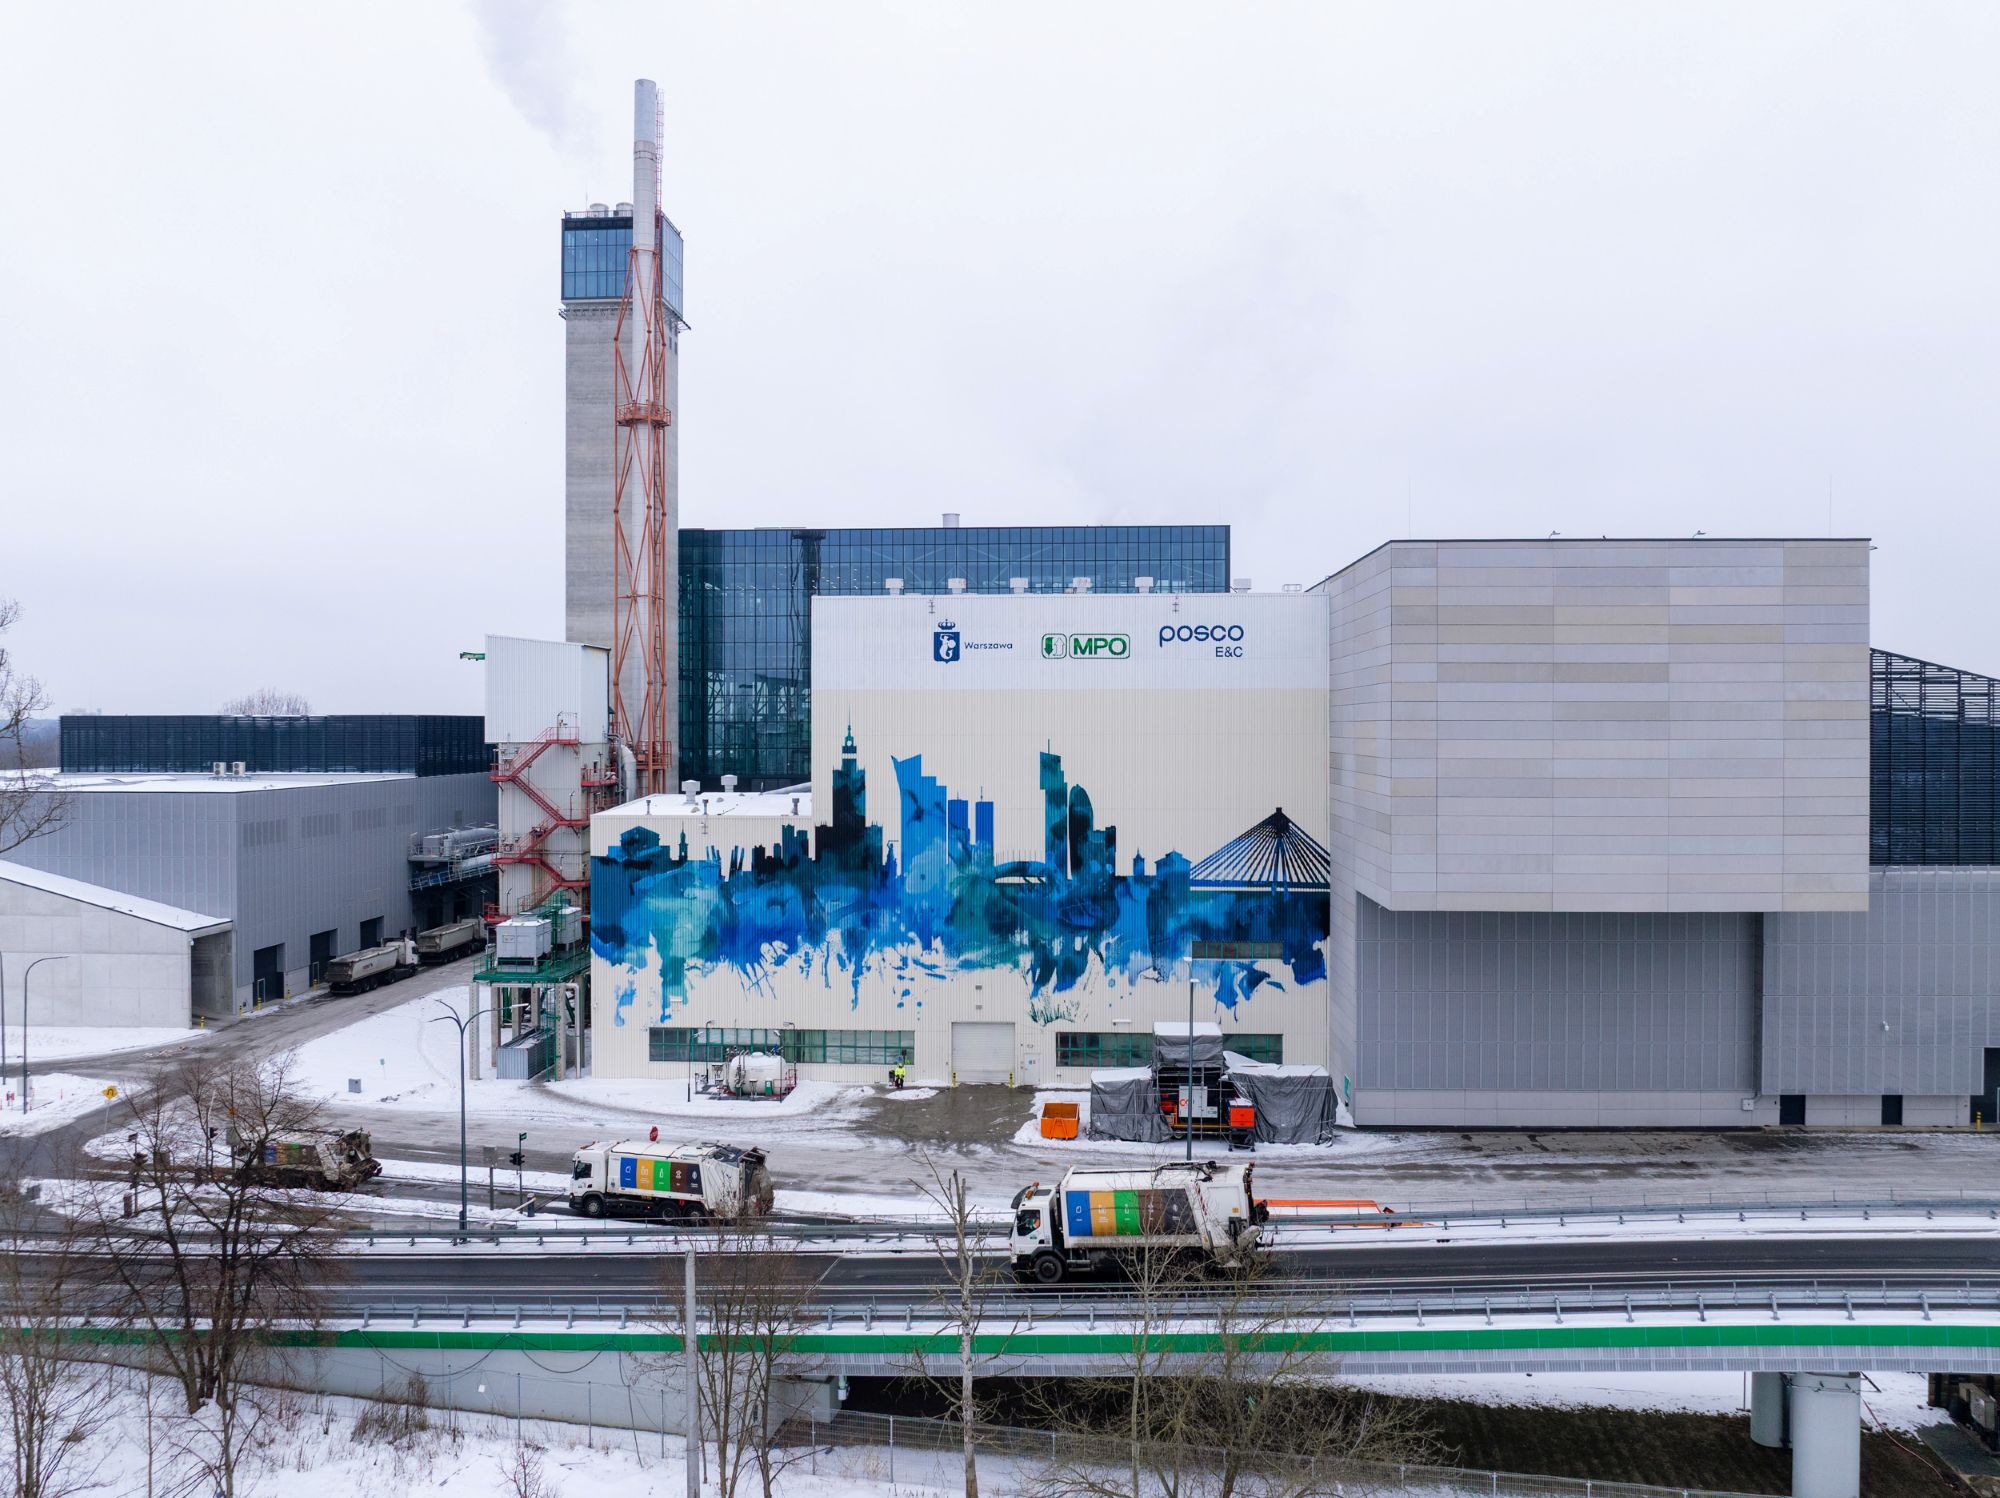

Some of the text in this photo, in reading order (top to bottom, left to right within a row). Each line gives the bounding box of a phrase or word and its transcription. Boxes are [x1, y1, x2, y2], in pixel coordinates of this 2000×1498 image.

[1159, 625, 1244, 648] posco
[964, 641, 1013, 649] Warszawa
[1073, 637, 1127, 656] MPO
[1215, 646, 1243, 658] E&C
